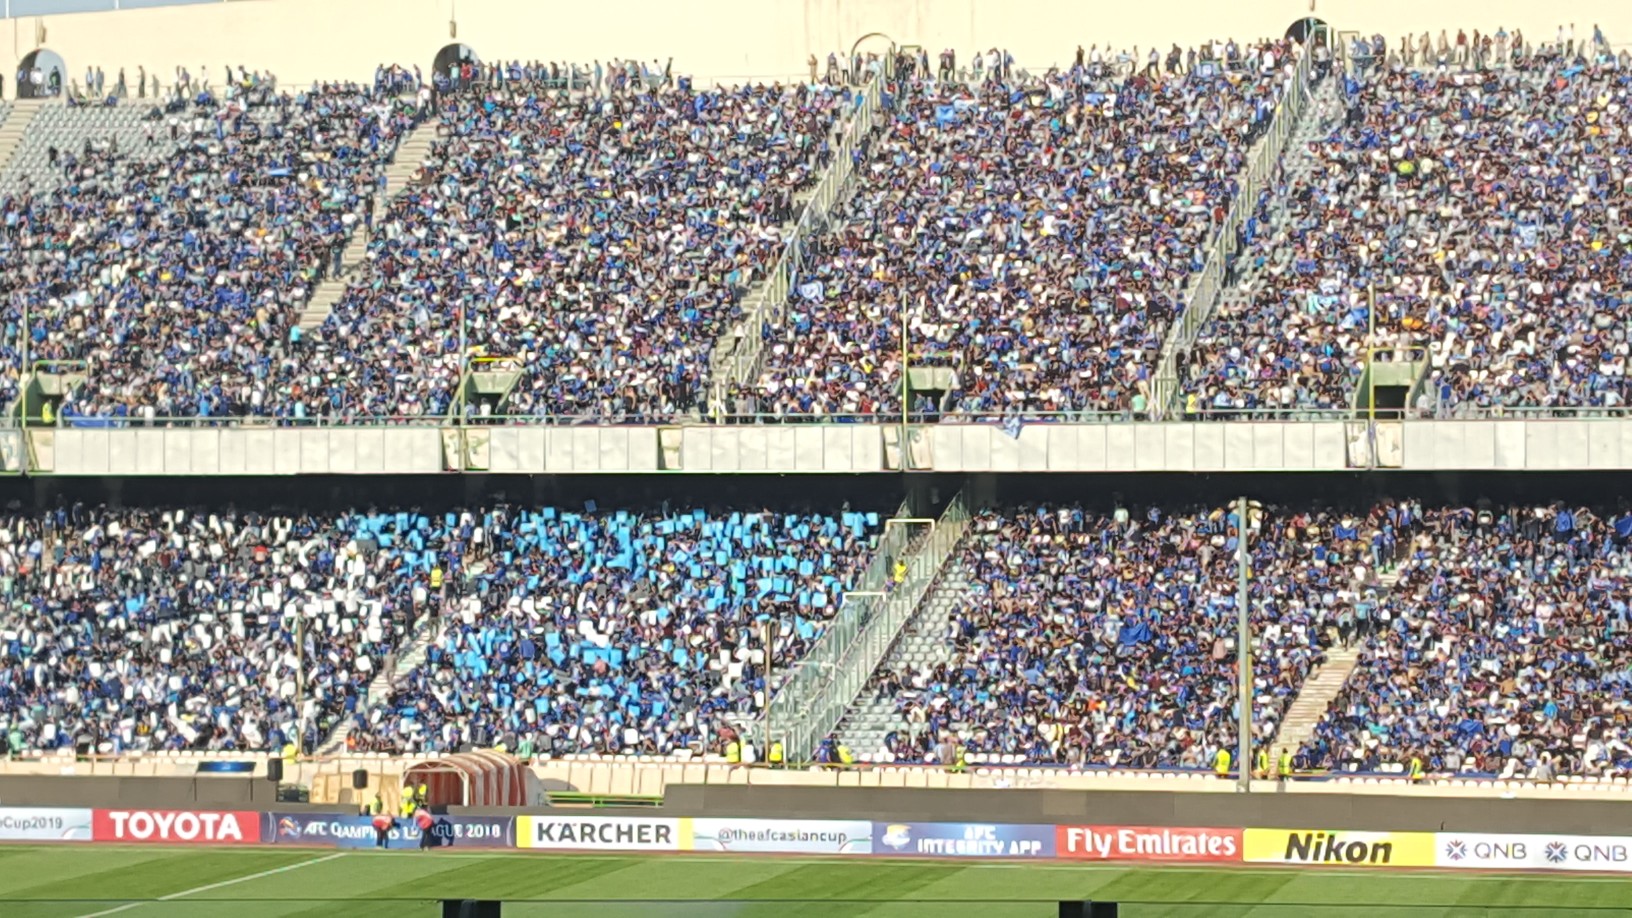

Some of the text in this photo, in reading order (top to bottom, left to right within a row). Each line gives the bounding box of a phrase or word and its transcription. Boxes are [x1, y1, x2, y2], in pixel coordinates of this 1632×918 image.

[0, 816, 63, 830] Cup2019
[109, 811, 243, 840] TOYOTA
[537, 822, 672, 844] KÄRCHER
[718, 827, 847, 844] @theafcasiancup
[964, 825, 996, 840] AFC
[918, 838, 1042, 855] INTEGRITY APP
[1067, 828, 1237, 858] Fly Emirates
[1284, 832, 1393, 863] Nikon
[1474, 842, 1527, 860] QNB
[1574, 844, 1628, 862] QNB
